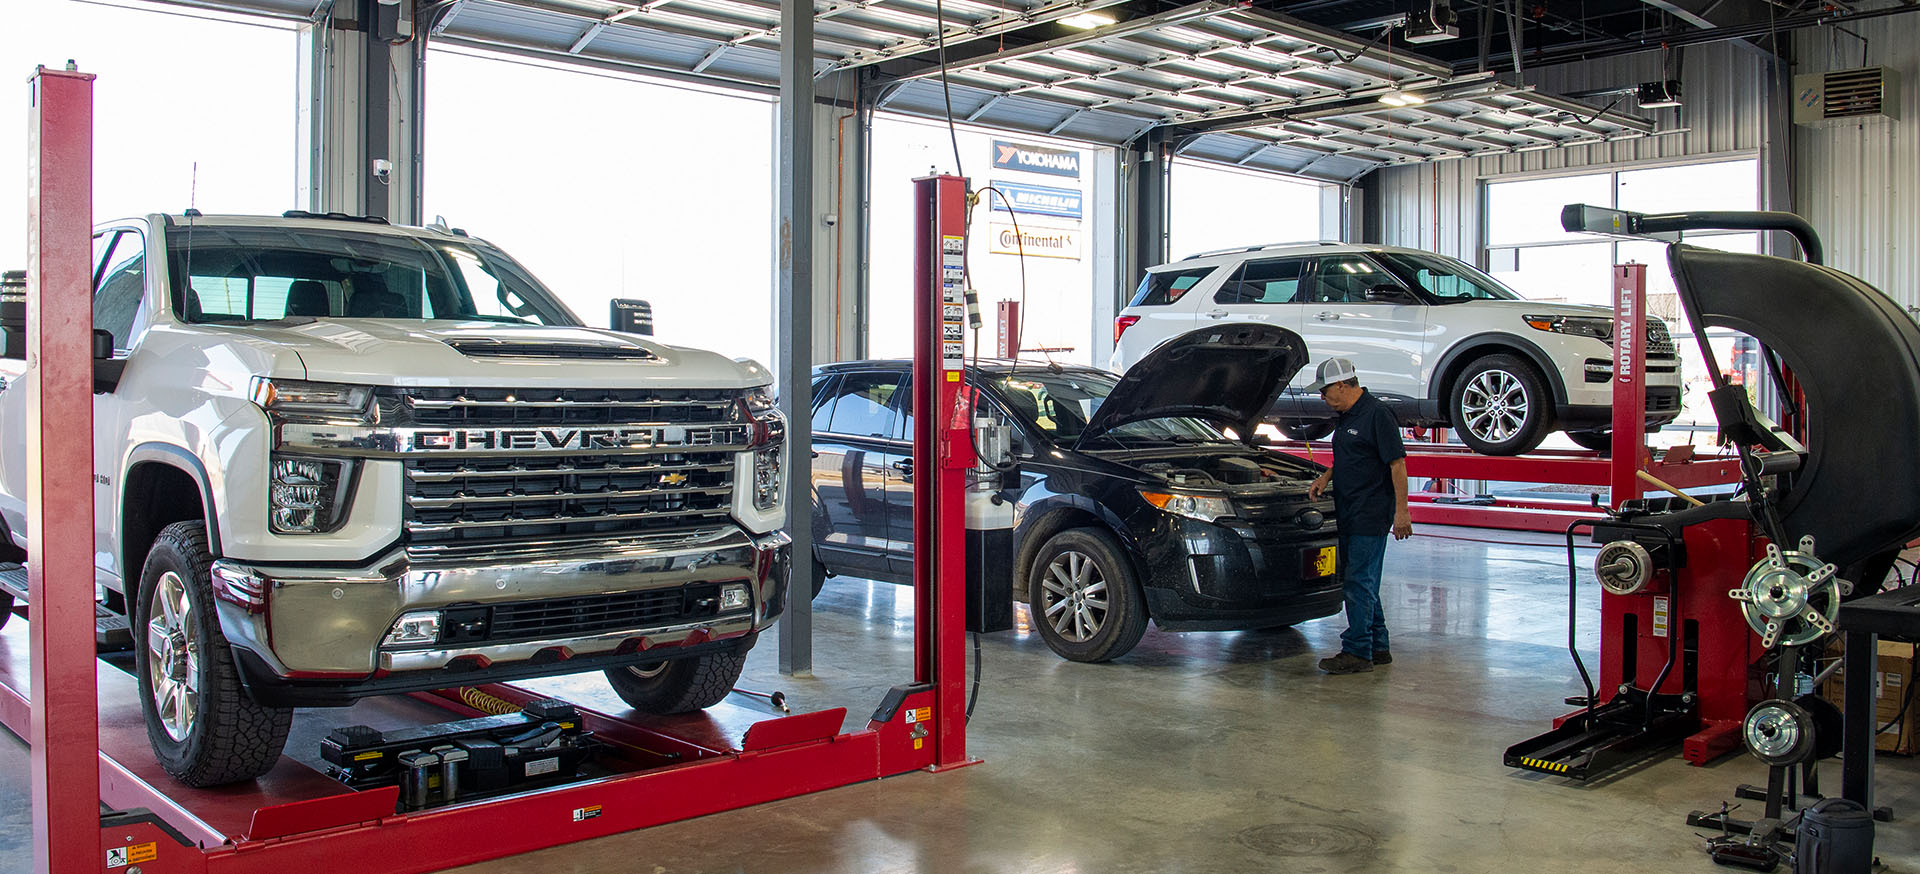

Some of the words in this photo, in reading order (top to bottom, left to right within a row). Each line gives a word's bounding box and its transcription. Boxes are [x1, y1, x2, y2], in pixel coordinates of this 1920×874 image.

[1016, 150, 1079, 171] YOKOHAMA
[1015, 192, 1080, 209] MICHELIN
[1000, 230, 1063, 249] Continental
[1621, 287, 1632, 317] LIFT
[1620, 320, 1631, 375] ROTARY
[413, 426, 747, 450] CHEVROLET
